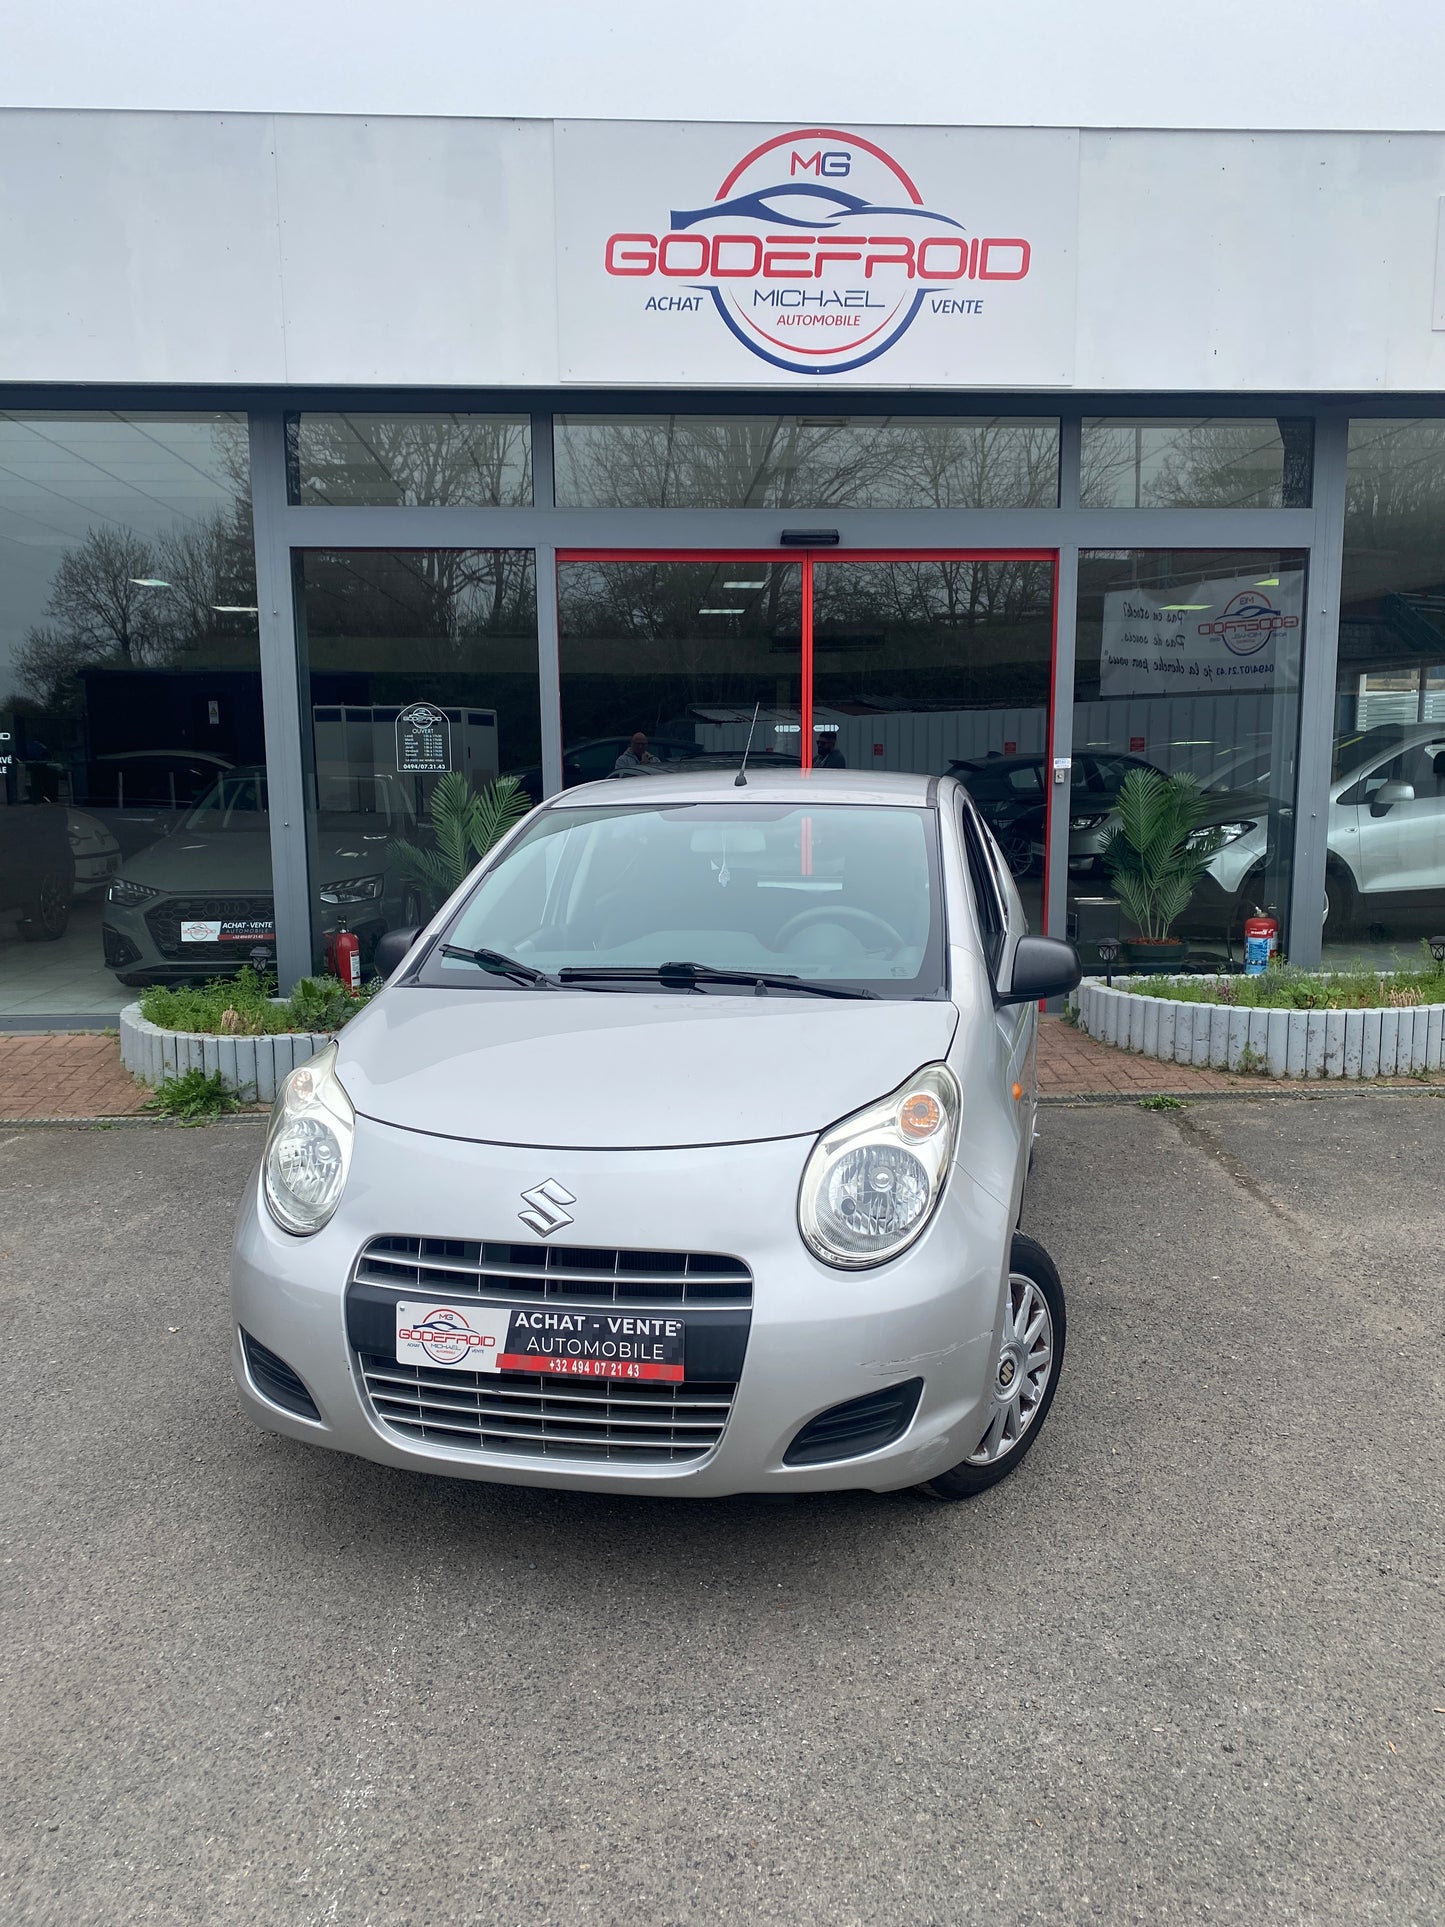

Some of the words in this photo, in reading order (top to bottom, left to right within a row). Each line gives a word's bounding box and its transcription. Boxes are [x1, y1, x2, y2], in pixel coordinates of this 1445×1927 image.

[790, 150, 851, 177] MG
[604, 233, 1032, 281] GODEFROID
[645, 296, 703, 312] ACHAT
[753, 289, 885, 308] MICHAEL
[931, 299, 984, 315] VENTE
[776, 314, 861, 327] AUTOMOBILE
[438, 1313, 454, 1321] MG
[515, 1312, 586, 1331] ACHAT
[607, 1318, 678, 1337] VENTE
[399, 1328, 496, 1347] GODEFROID
[526, 1336, 664, 1360] AUTOMOBILE
[549, 1359, 567, 1372] +32
[571, 1361, 590, 1374] 494
[595, 1362, 606, 1375] 07
[611, 1363, 624, 1376] 21
[627, 1364, 640, 1377] 43
